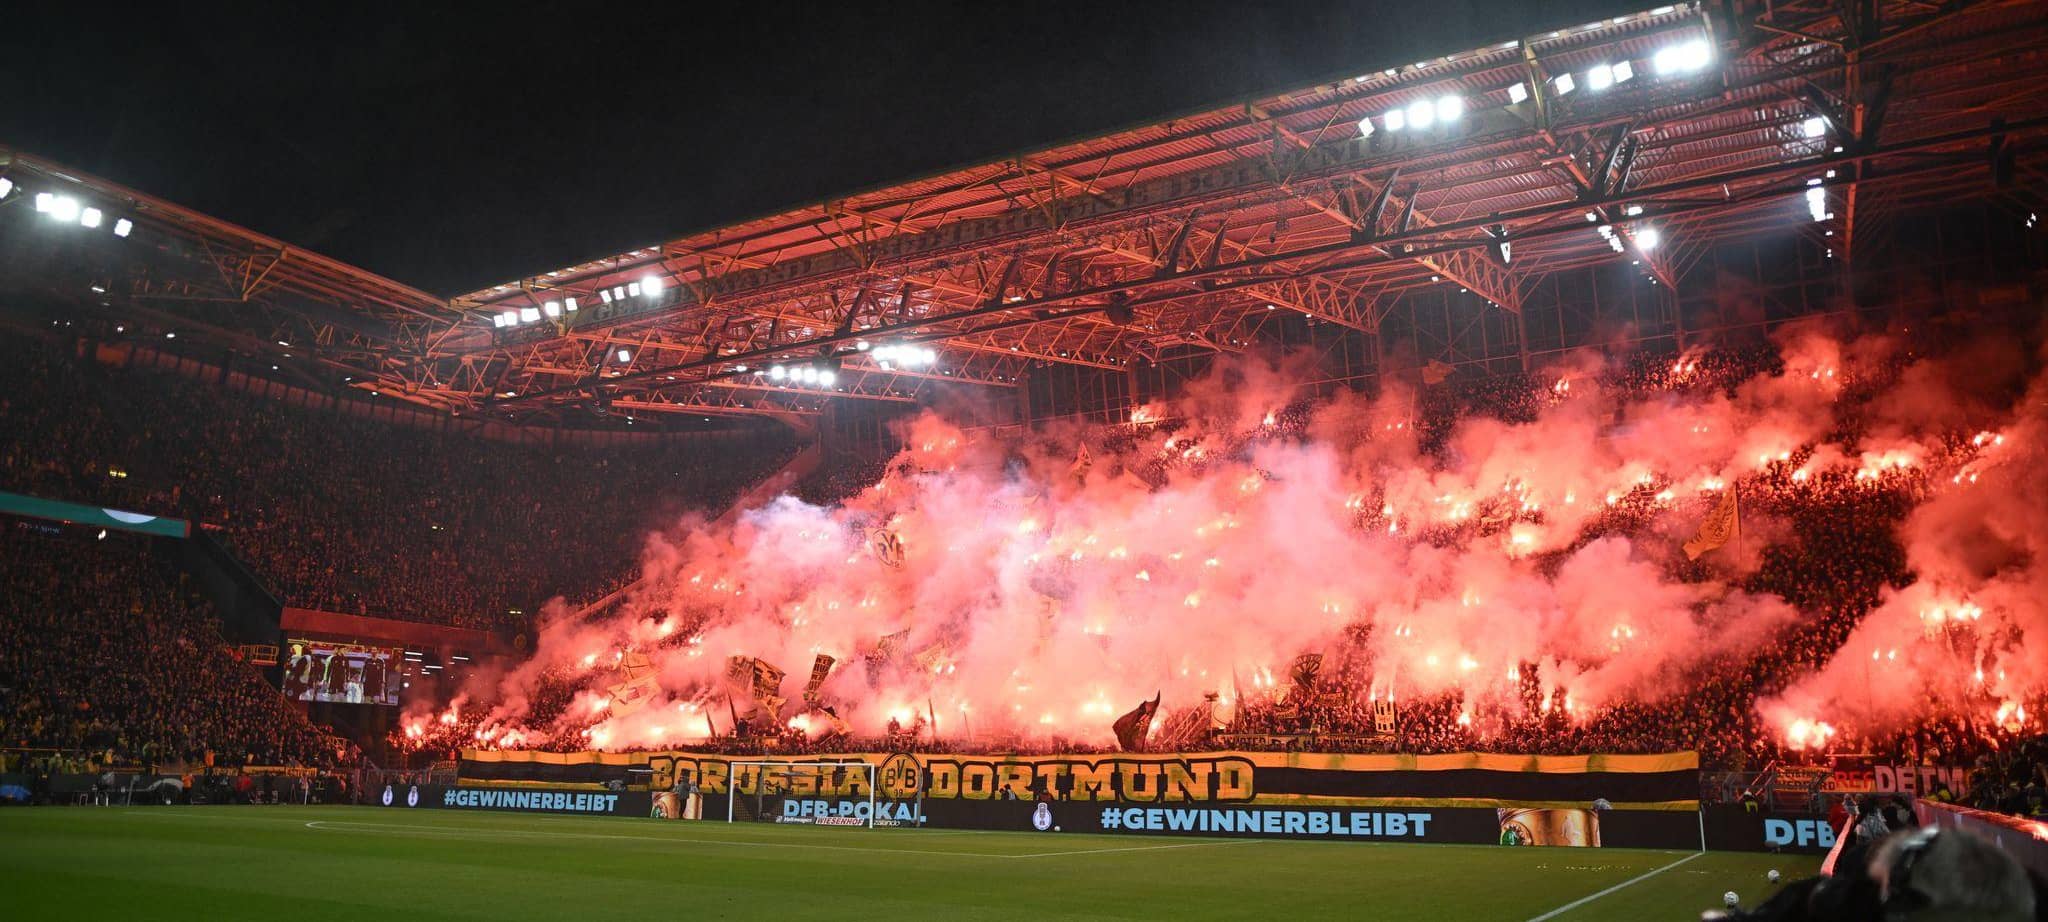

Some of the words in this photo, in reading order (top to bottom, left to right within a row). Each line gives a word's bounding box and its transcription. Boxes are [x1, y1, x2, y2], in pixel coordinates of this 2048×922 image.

[649, 756, 871, 794] BORUSSIA
[885, 759, 916, 788] BVB
[926, 758, 1257, 802] DORTMUND
[444, 789, 619, 813] #GEWINNERBLEIBT
[1101, 807, 1432, 839] #GEWINNERBLEIBT
